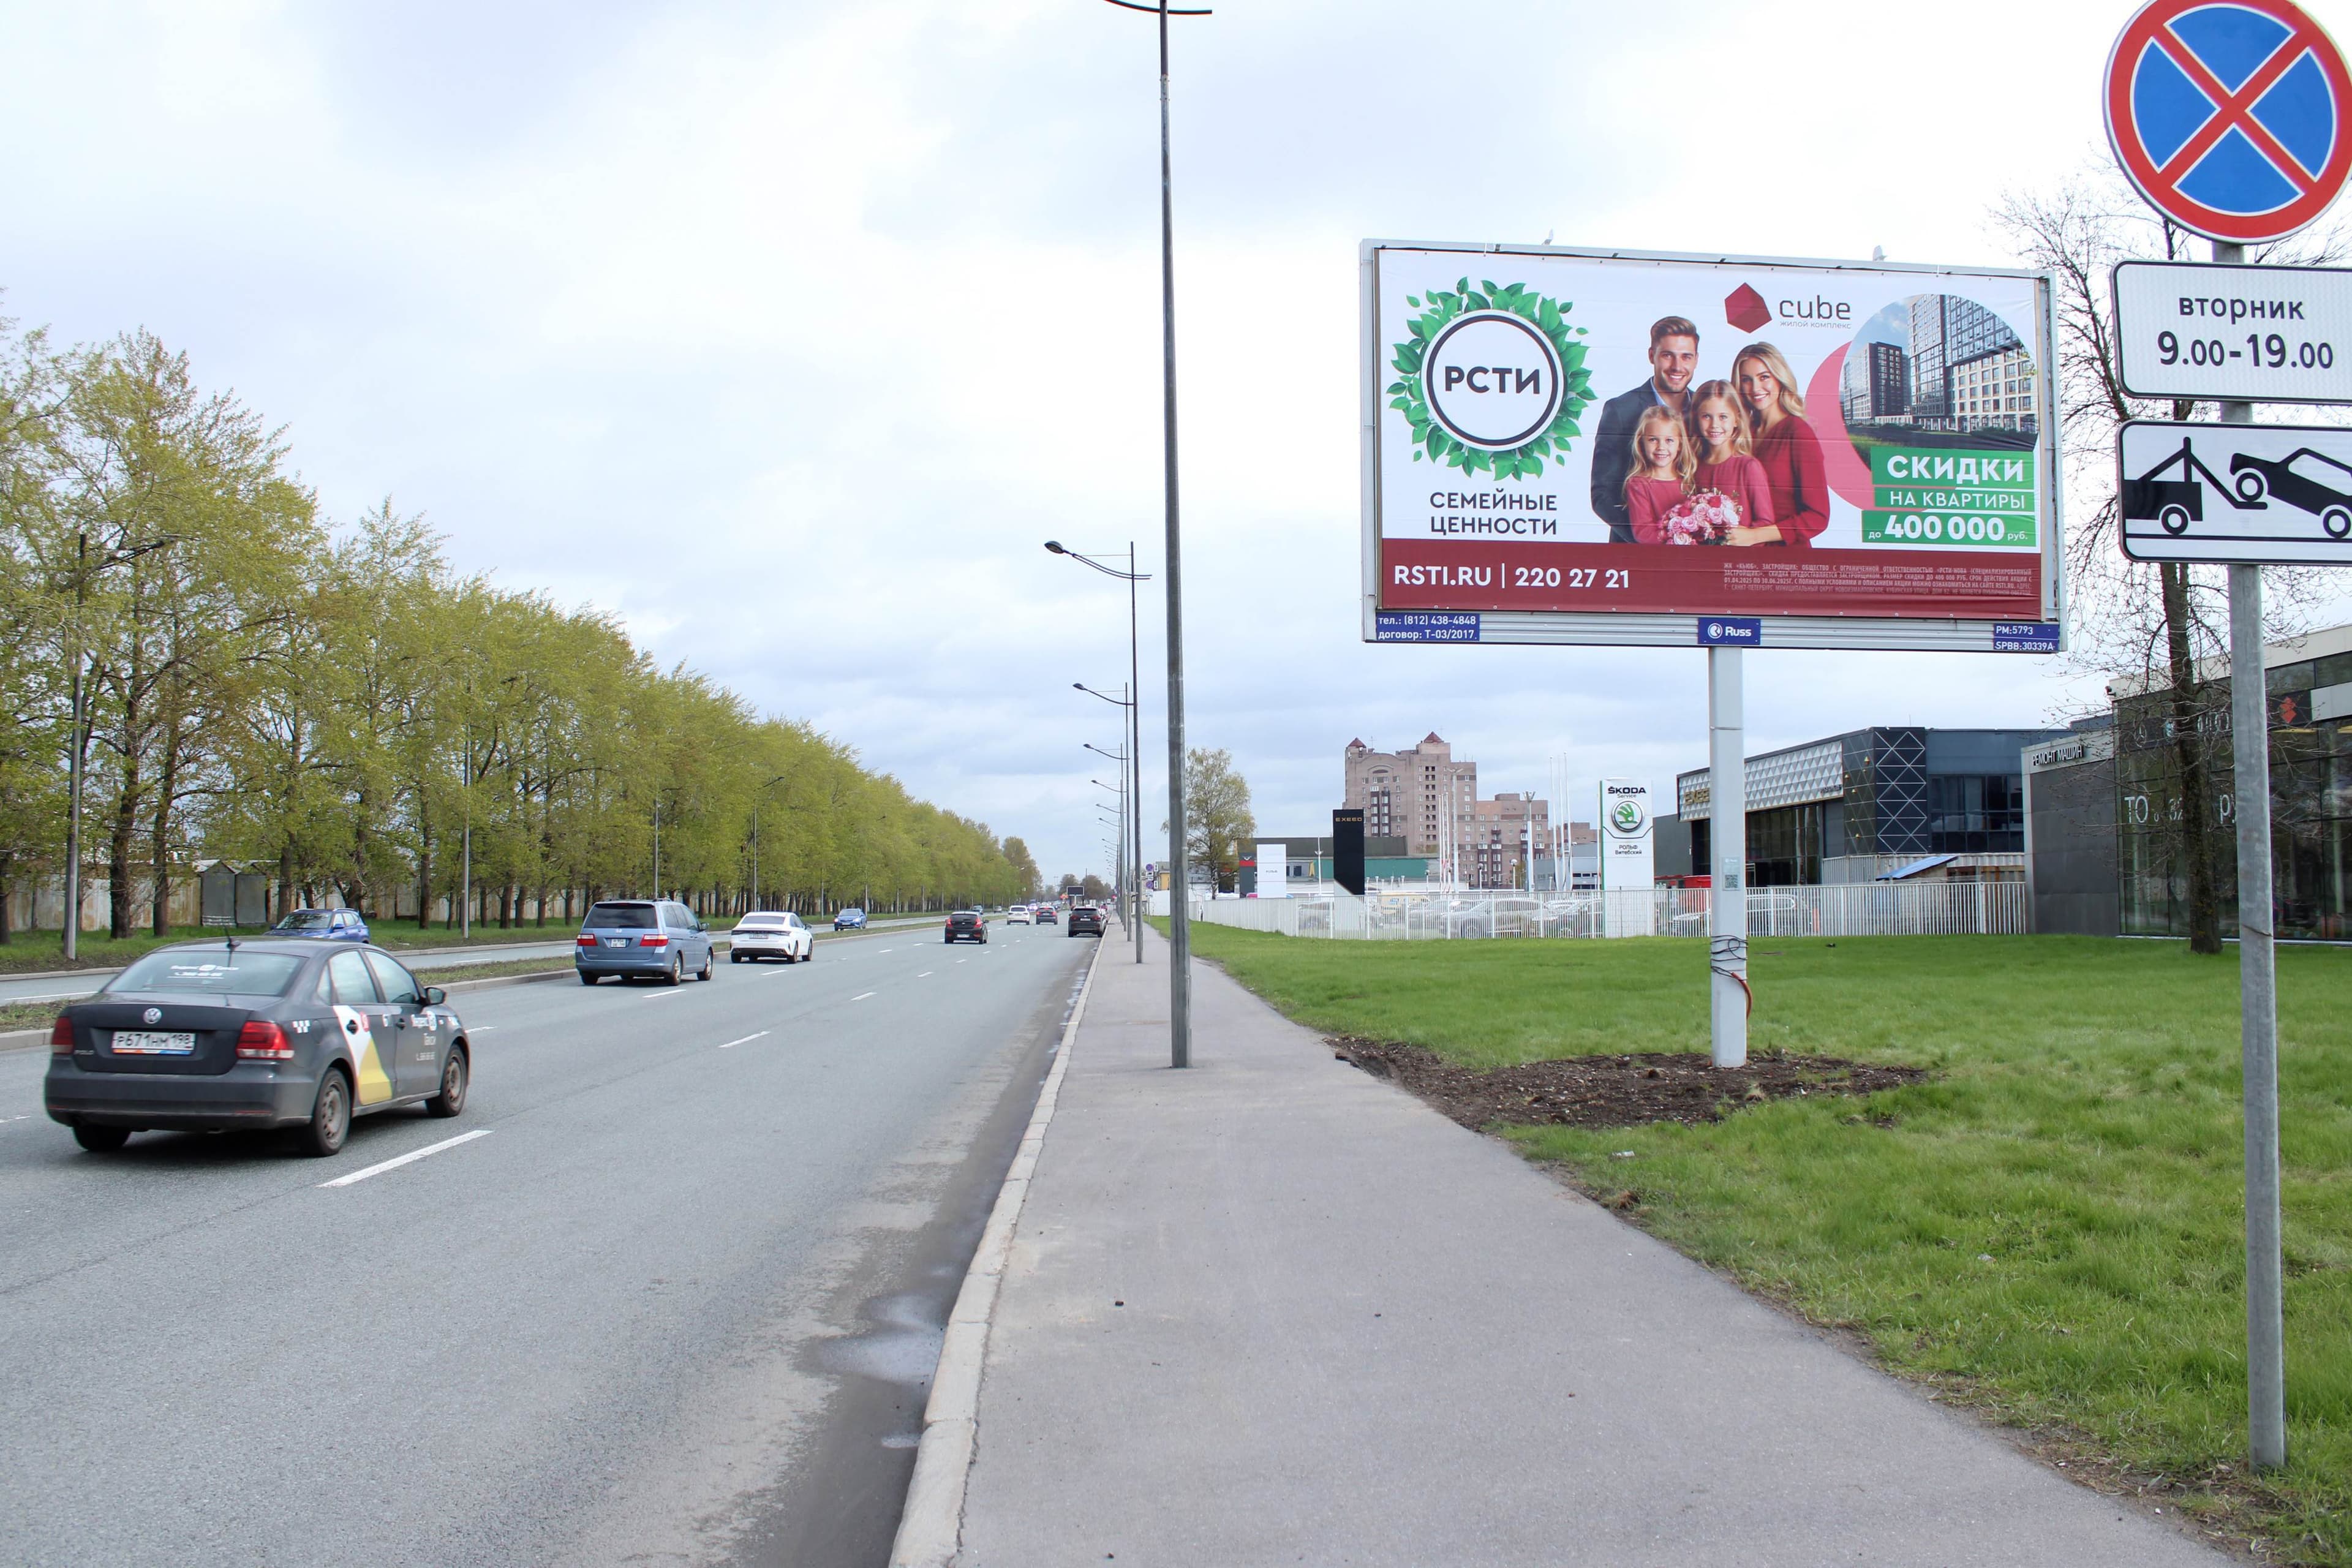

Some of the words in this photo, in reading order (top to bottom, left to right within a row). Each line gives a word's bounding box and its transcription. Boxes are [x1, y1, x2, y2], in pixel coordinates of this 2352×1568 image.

[1779, 295, 1850, 320] cube
[2179, 297, 2304, 325] вторник
[2157, 331, 2333, 369] 9.00-19.00
[1445, 366, 1540, 394] РСТИ
[1887, 456, 2023, 484] СКИДКИ
[1430, 488, 1557, 511] СЕМЕЙНЫЕ
[1890, 491, 1916, 506] НА
[1923, 492, 2025, 509] КВАРТИРЫ
[1431, 516, 1556, 536] ЦЕННОСТИ
[1869, 531, 1881, 540] до
[1885, 514, 1942, 540] 400
[1947, 516, 2005, 541] 000
[2007, 532, 2028, 541] руб.
[1394, 565, 1491, 586] RSTI.RU
[1515, 567, 1561, 587] 220
[1569, 568, 1597, 587] 27
[1605, 569, 1629, 588] 21
[1404, 615, 1428, 625] (812)
[1431, 616, 1476, 625] 438-4848
[1378, 631, 1422, 641] договор:
[1725, 626, 1752, 636] Russ
[1995, 641, 2054, 650] SPBB:30339A
[2032, 750, 2056, 766] РЕМОНТ
[1684, 788, 1710, 805] EXEE
